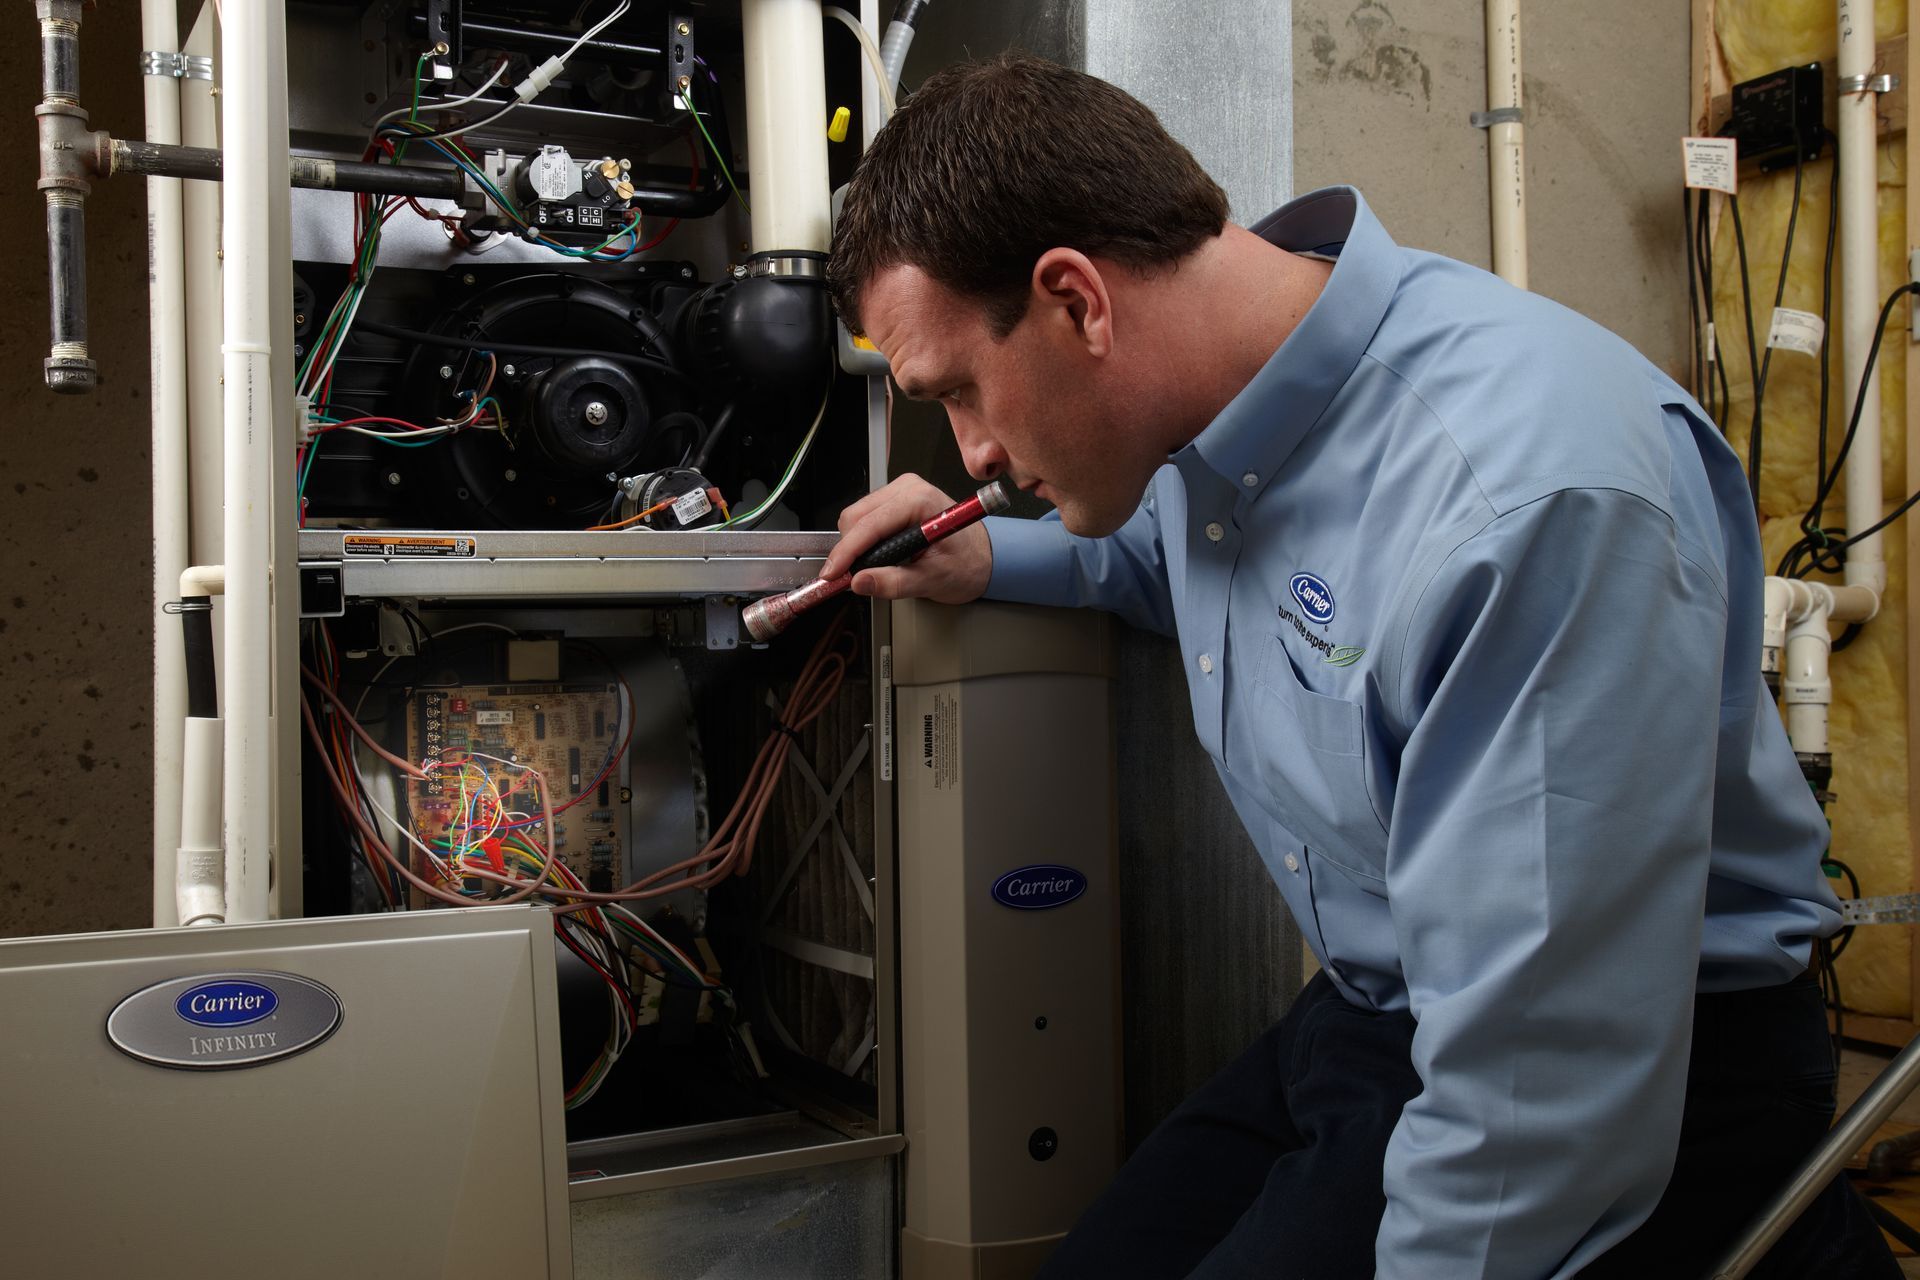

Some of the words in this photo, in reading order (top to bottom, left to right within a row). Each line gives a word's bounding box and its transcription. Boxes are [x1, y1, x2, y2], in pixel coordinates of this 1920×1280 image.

[584, 172, 592, 180] HI
[567, 208, 574, 223] ON
[1298, 579, 1330, 614] Carrier
[1278, 605, 1294, 624] turn
[924, 715, 932, 758] WARNING
[1007, 877, 1074, 896] Carrier
[190, 992, 264, 1013] Carrier
[190, 1032, 277, 1055] INFINITY
